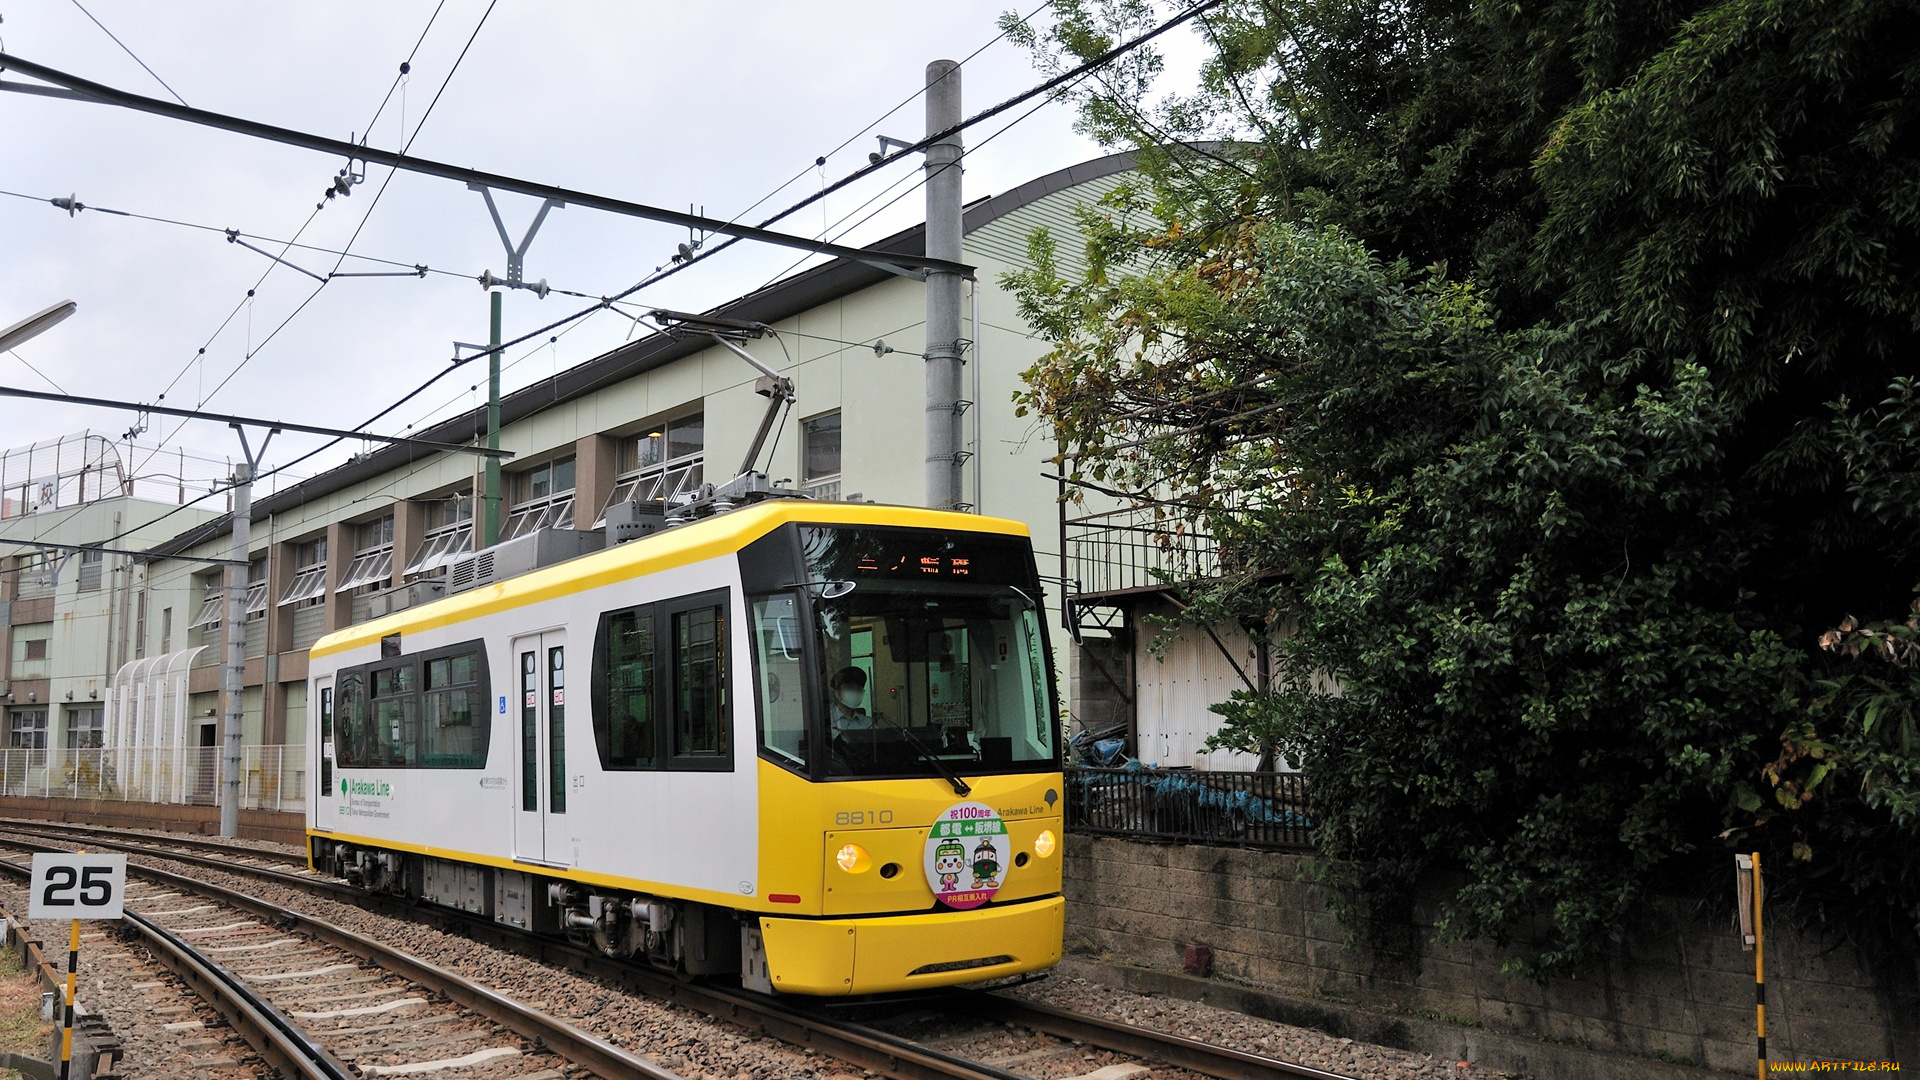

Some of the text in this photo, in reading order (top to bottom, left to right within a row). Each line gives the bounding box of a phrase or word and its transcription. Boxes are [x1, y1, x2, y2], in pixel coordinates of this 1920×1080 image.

[41, 482, 54, 506] 校
[352, 778, 390, 797] Arakawa Line
[835, 809, 893, 826] 8810
[950, 807, 991, 820] 祝100周年
[997, 805, 1044, 817] Arakawa Line
[43, 866, 113, 906] 25
